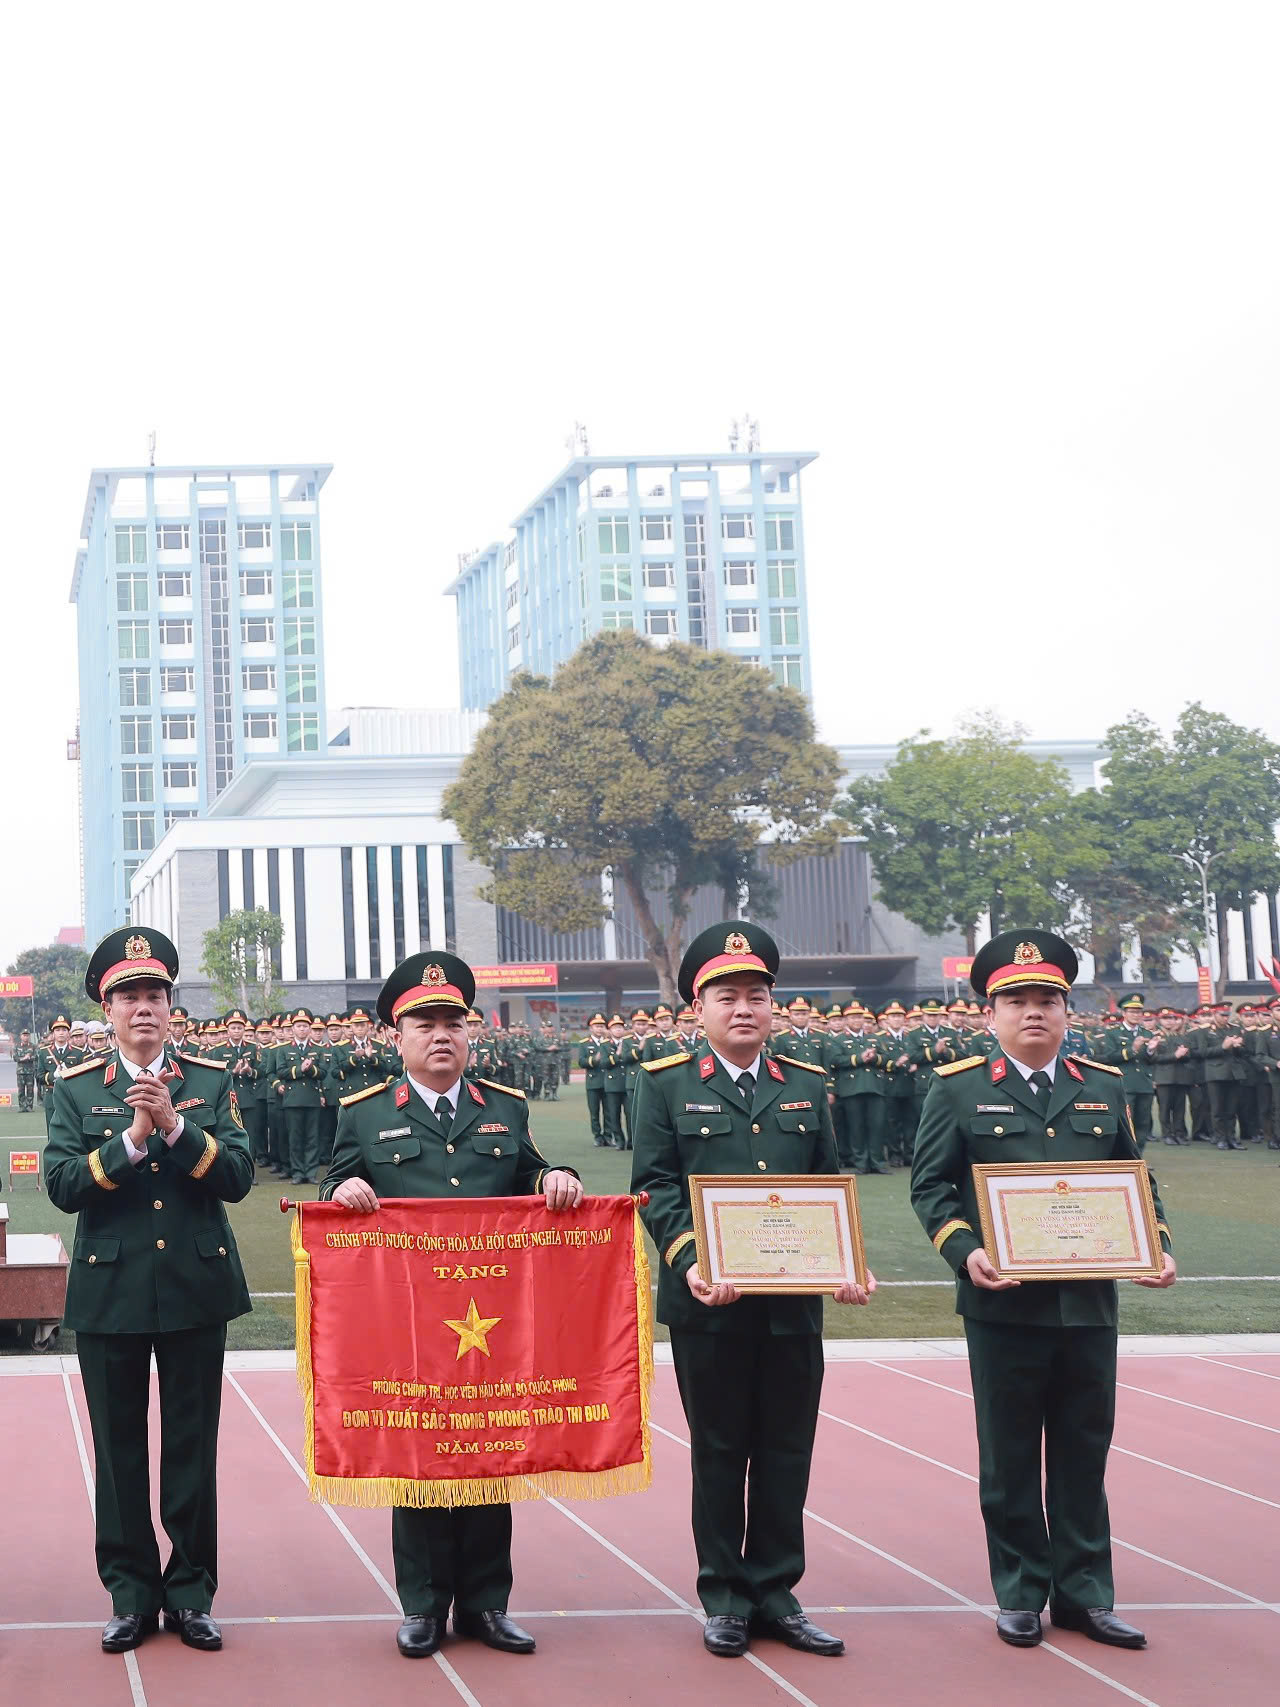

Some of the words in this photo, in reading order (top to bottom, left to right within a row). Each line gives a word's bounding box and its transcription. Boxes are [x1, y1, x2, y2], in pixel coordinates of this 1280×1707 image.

[326, 1230, 360, 1248] CHÍNH
[361, 1226, 384, 1247] PHỦ
[386, 1231, 415, 1250] NƯỚC
[417, 1232, 445, 1254] CỘNG
[447, 1234, 469, 1252] HÒA
[470, 1232, 484, 1250] XÃ
[486, 1231, 505, 1253] HỘI
[507, 1228, 529, 1249] CHỦ
[530, 1227, 562, 1247] NGHĨA
[564, 1227, 588, 1248] VIỆT
[590, 1228, 612, 1245] NAM
[432, 1264, 509, 1283] TẶNG
[372, 1377, 400, 1396] PHÒNG
[402, 1380, 427, 1398] CHÍNH
[429, 1384, 443, 1403] TRỊ,
[444, 1386, 459, 1404] HỌC
[494, 1377, 515, 1398] CẦN,
[516, 1378, 527, 1399] BỘ
[529, 1375, 551, 1396] QUỐC
[552, 1375, 577, 1393] PHÒNG
[342, 1410, 370, 1428] ĐƠN
[371, 1410, 384, 1430] VỊ
[387, 1406, 419, 1429] XUẤT
[449, 1412, 485, 1430] TRONG
[488, 1410, 531, 1428] PHONG
[533, 1404, 564, 1425] TRÀO
[565, 1406, 582, 1424] THI
[585, 1403, 611, 1422] ĐUA
[435, 1440, 481, 1454] NĂM
[484, 1440, 526, 1453] 2025
